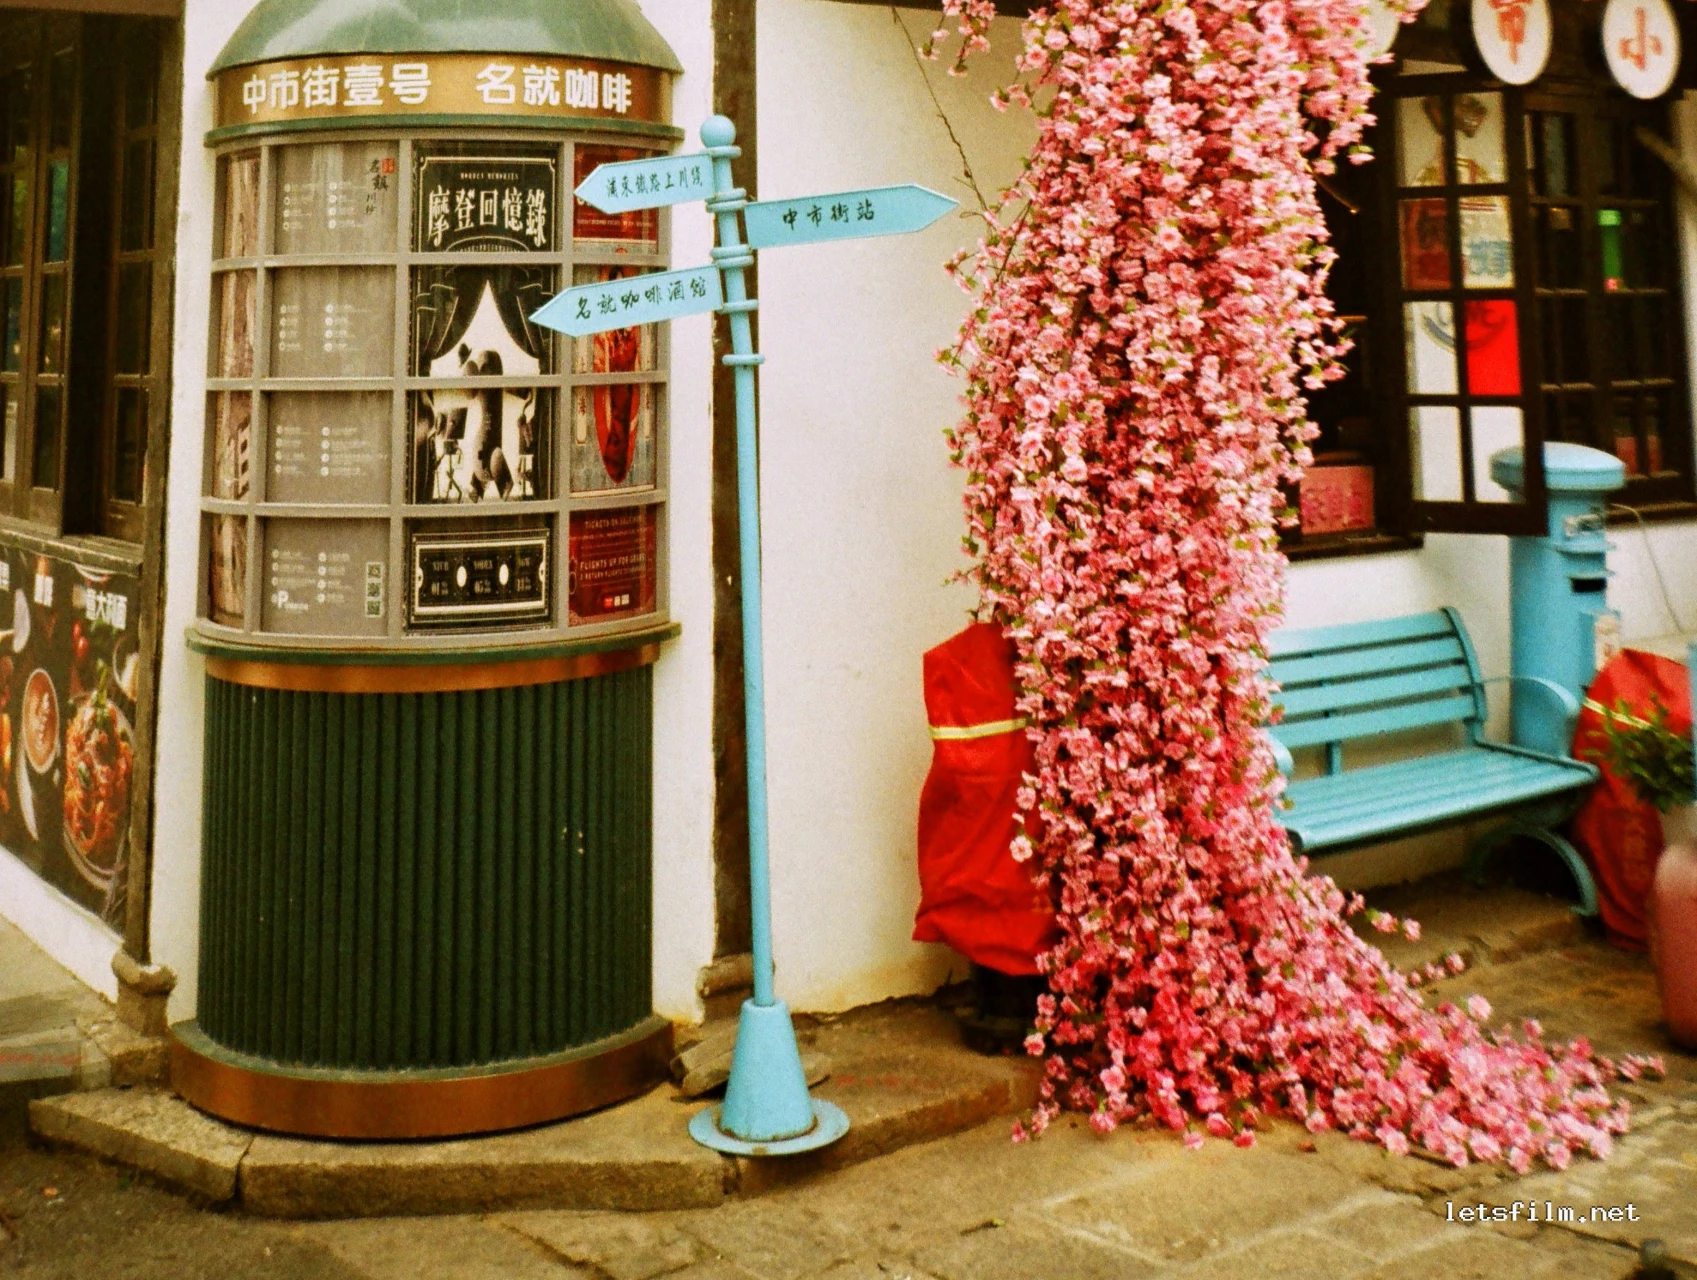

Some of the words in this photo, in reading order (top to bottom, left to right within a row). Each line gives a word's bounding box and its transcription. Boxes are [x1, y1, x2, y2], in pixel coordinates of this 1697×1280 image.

[242, 63, 433, 114] 中市街壹号
[475, 63, 633, 114] 名就咖啡
[428, 184, 547, 248] 摩登回憶錄
[782, 197, 875, 232] 中市街站
